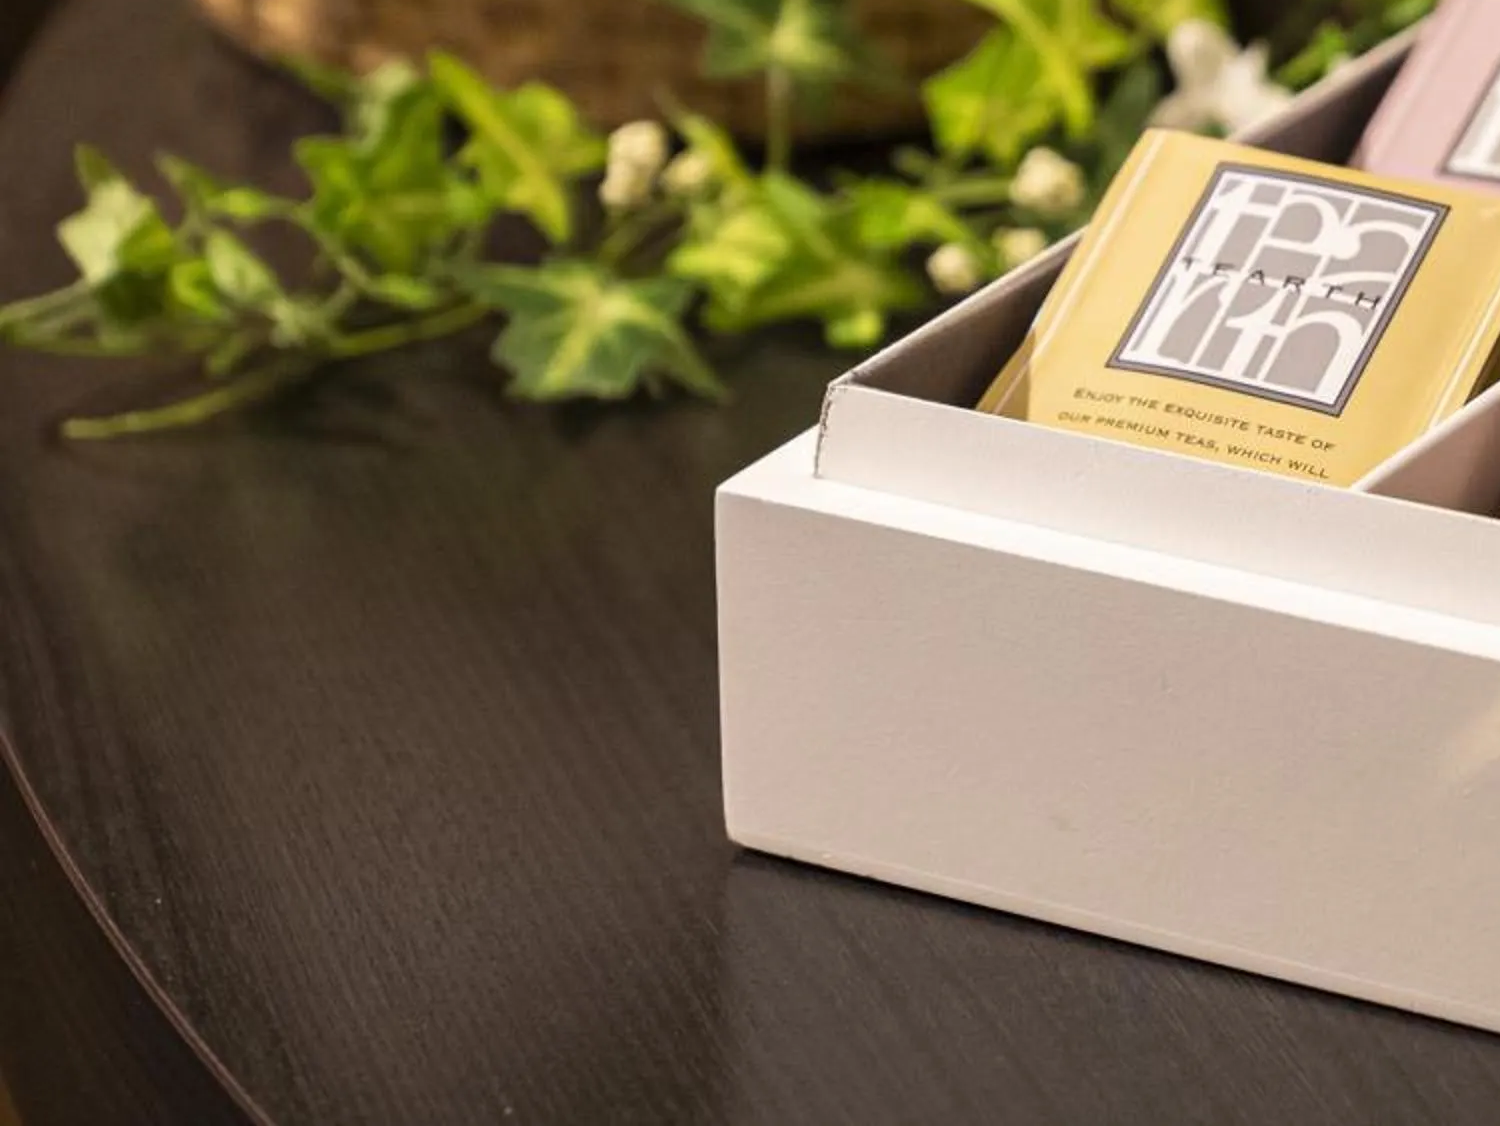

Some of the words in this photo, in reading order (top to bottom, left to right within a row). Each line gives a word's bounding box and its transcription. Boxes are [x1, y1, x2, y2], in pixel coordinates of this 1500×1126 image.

[1183, 255, 1381, 310] TEARTH
[1057, 411, 1091, 423] OUR
[1095, 416, 1171, 438] PREMIUM
[1176, 431, 1221, 453] TEAS,
[1227, 444, 1282, 466] WHICH
[1288, 459, 1330, 479] WILL
[1073, 387, 1123, 404] ENJOY
[1128, 396, 1158, 410] THE
[1164, 402, 1250, 432] EXQUISITE
[1256, 425, 1307, 445] TASTE
[1311, 439, 1337, 452] OF
